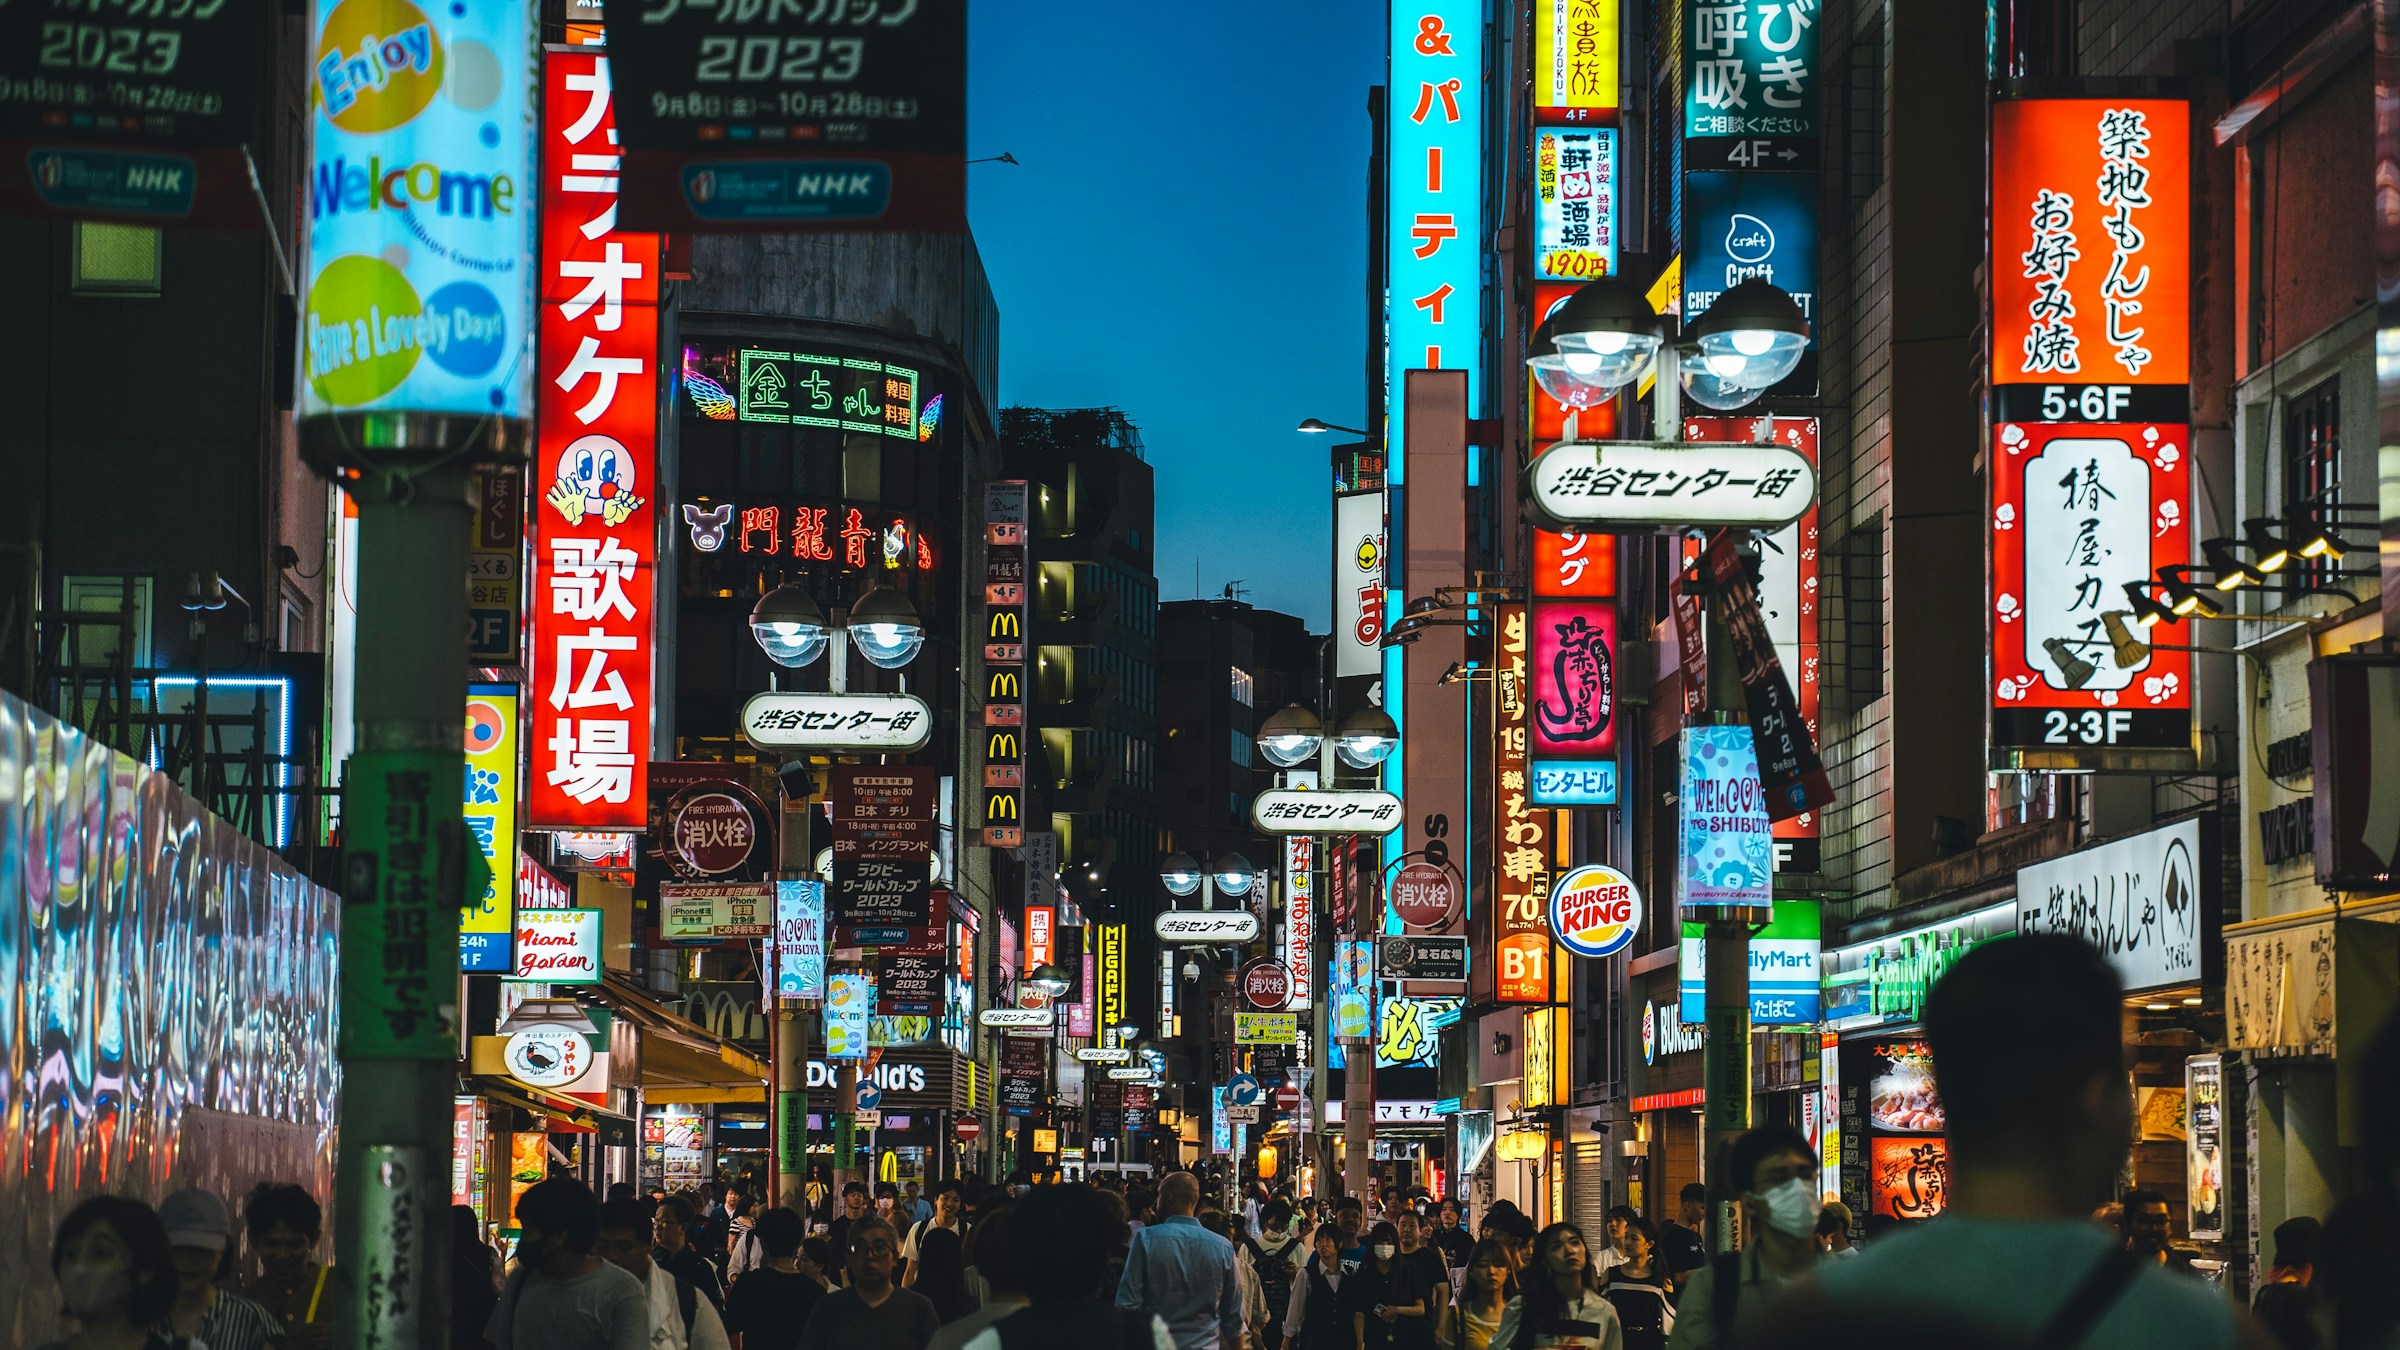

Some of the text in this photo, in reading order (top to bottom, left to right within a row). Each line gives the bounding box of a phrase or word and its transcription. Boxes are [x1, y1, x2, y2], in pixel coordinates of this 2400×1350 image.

[39, 21, 183, 75] 2023
[695, 36, 866, 83] 2023
[1695, 5, 1748, 111] 呼吸
[318, 23, 433, 117] Enjoy
[1565, 109, 1588, 120] 4F
[1694, 116, 1810, 134] ご相談ください
[1727, 140, 1772, 168] 4F
[1541, 135, 1556, 200] 激安酒場
[127, 166, 184, 193] NHK
[312, 155, 516, 220] Welcome
[797, 173, 873, 198] NHK
[1560, 133, 1594, 248] 一軒め酒場
[1732, 232, 1767, 248] craft
[2100, 107, 2152, 376] 築地もんじゃ
[1545, 254, 1608, 277] 190円
[2022, 188, 2081, 374] お好み焼
[748, 361, 881, 417] 金ちゃん
[885, 378, 912, 402] 韓国
[885, 403, 912, 426] 料理
[1549, 467, 1801, 499] 渋谷センター街
[489, 478, 508, 540] ほぐし
[546, 536, 639, 806] 歌広場
[1568, 650, 1599, 733] 赤ちり亭
[753, 709, 920, 731] 渋谷センター街
[1535, 771, 1614, 795] センタービル
[688, 805, 704, 815] FIRE
[854, 805, 909, 817] 日本 チリ
[1263, 803, 1397, 820] 渋谷センター街
[683, 817, 748, 849] 消火栓
[1691, 816, 1772, 835] TO SHIBUYA
[834, 839, 929, 852] 日本 イングランド
[857, 863, 903, 877] ラグビー
[1401, 871, 1443, 881] FIRE HYDRANT
[483, 872, 497, 914] めし
[842, 878, 921, 893] ワールドカップ
[1396, 883, 1449, 909] 消火栓
[1690, 891, 1729, 899] SHIBUYA
[727, 896, 757, 905] iPhone
[732, 905, 753, 915] 修理
[856, 894, 903, 907] 2023
[1560, 885, 1630, 913] BURGER
[730, 916, 756, 925] 救急便
[1160, 920, 1252, 933] 渋谷センター街
[1562, 900, 1632, 937] KING
[517, 927, 578, 947] Miami
[773, 918, 818, 943] LCOME
[882, 930, 904, 938] NHK
[896, 958, 928, 968] ラグビー
[1417, 948, 1463, 961] 宝石広場
[1503, 946, 1543, 980] B1
[885, 969, 940, 979] ワールドカップ
[895, 979, 928, 989] 2023
[1105, 926, 1119, 1025] MEGAドンキ
[1249, 977, 1285, 994] 消火栓
[1339, 982, 1382, 996] Welcoe
[984, 1013, 1048, 1022] 渋谷センター街
[1754, 999, 1797, 1018] たばこ
[563, 1039, 576, 1076] 夕やけ
[1010, 1092, 1030, 1100] 2023
